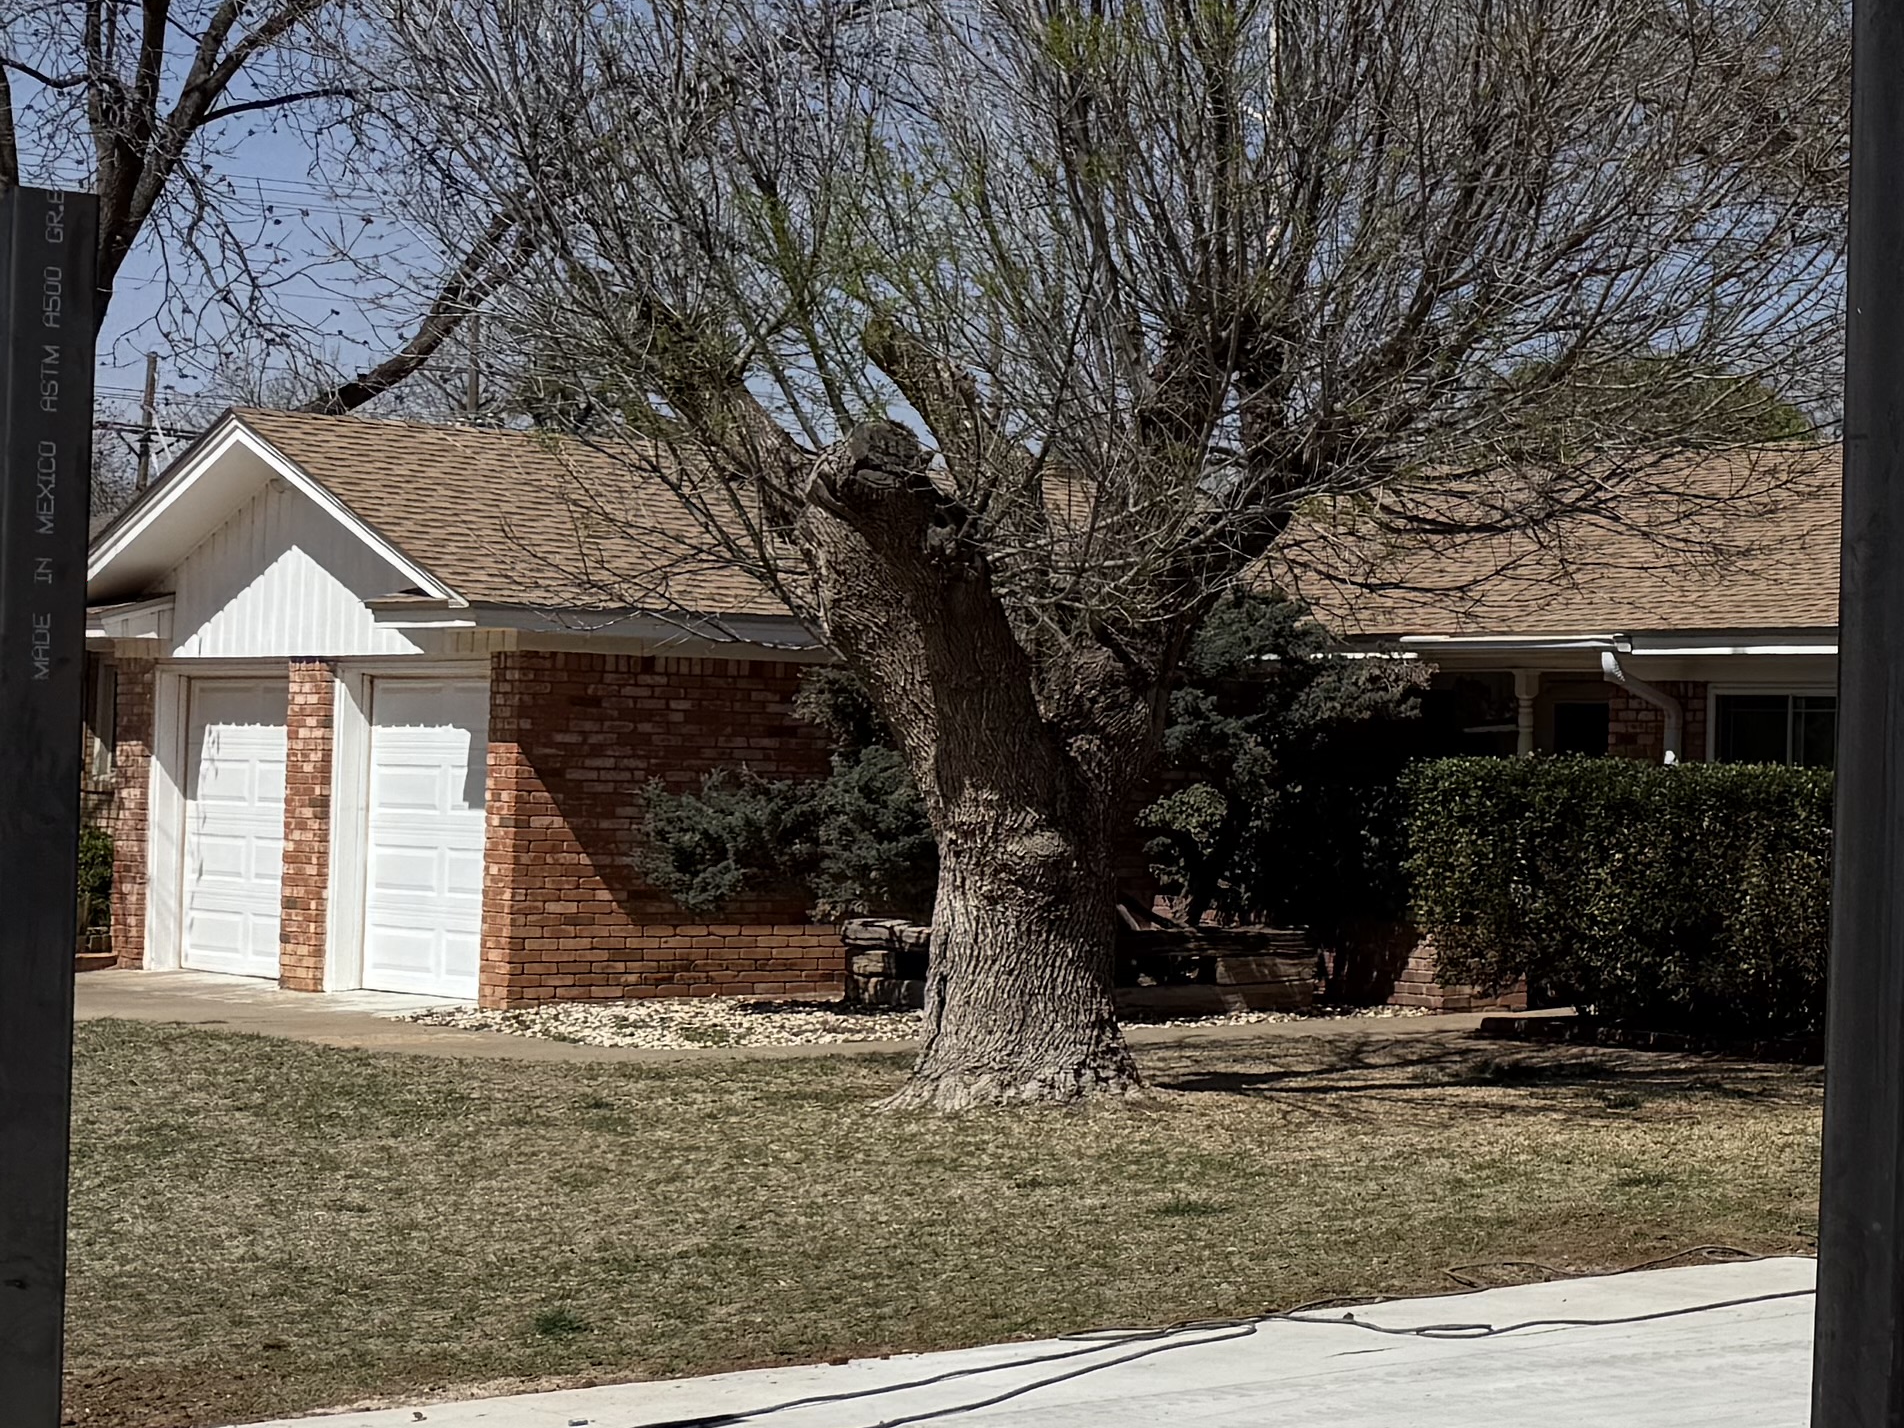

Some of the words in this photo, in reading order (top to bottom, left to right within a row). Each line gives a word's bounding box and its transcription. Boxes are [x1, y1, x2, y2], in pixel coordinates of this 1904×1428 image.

[42, 266, 63, 328] A500
[40, 345, 61, 412] ASTM
[35, 440, 58, 534] MEXICO
[33, 557, 53, 584] IN
[32, 612, 53, 681] MADE
